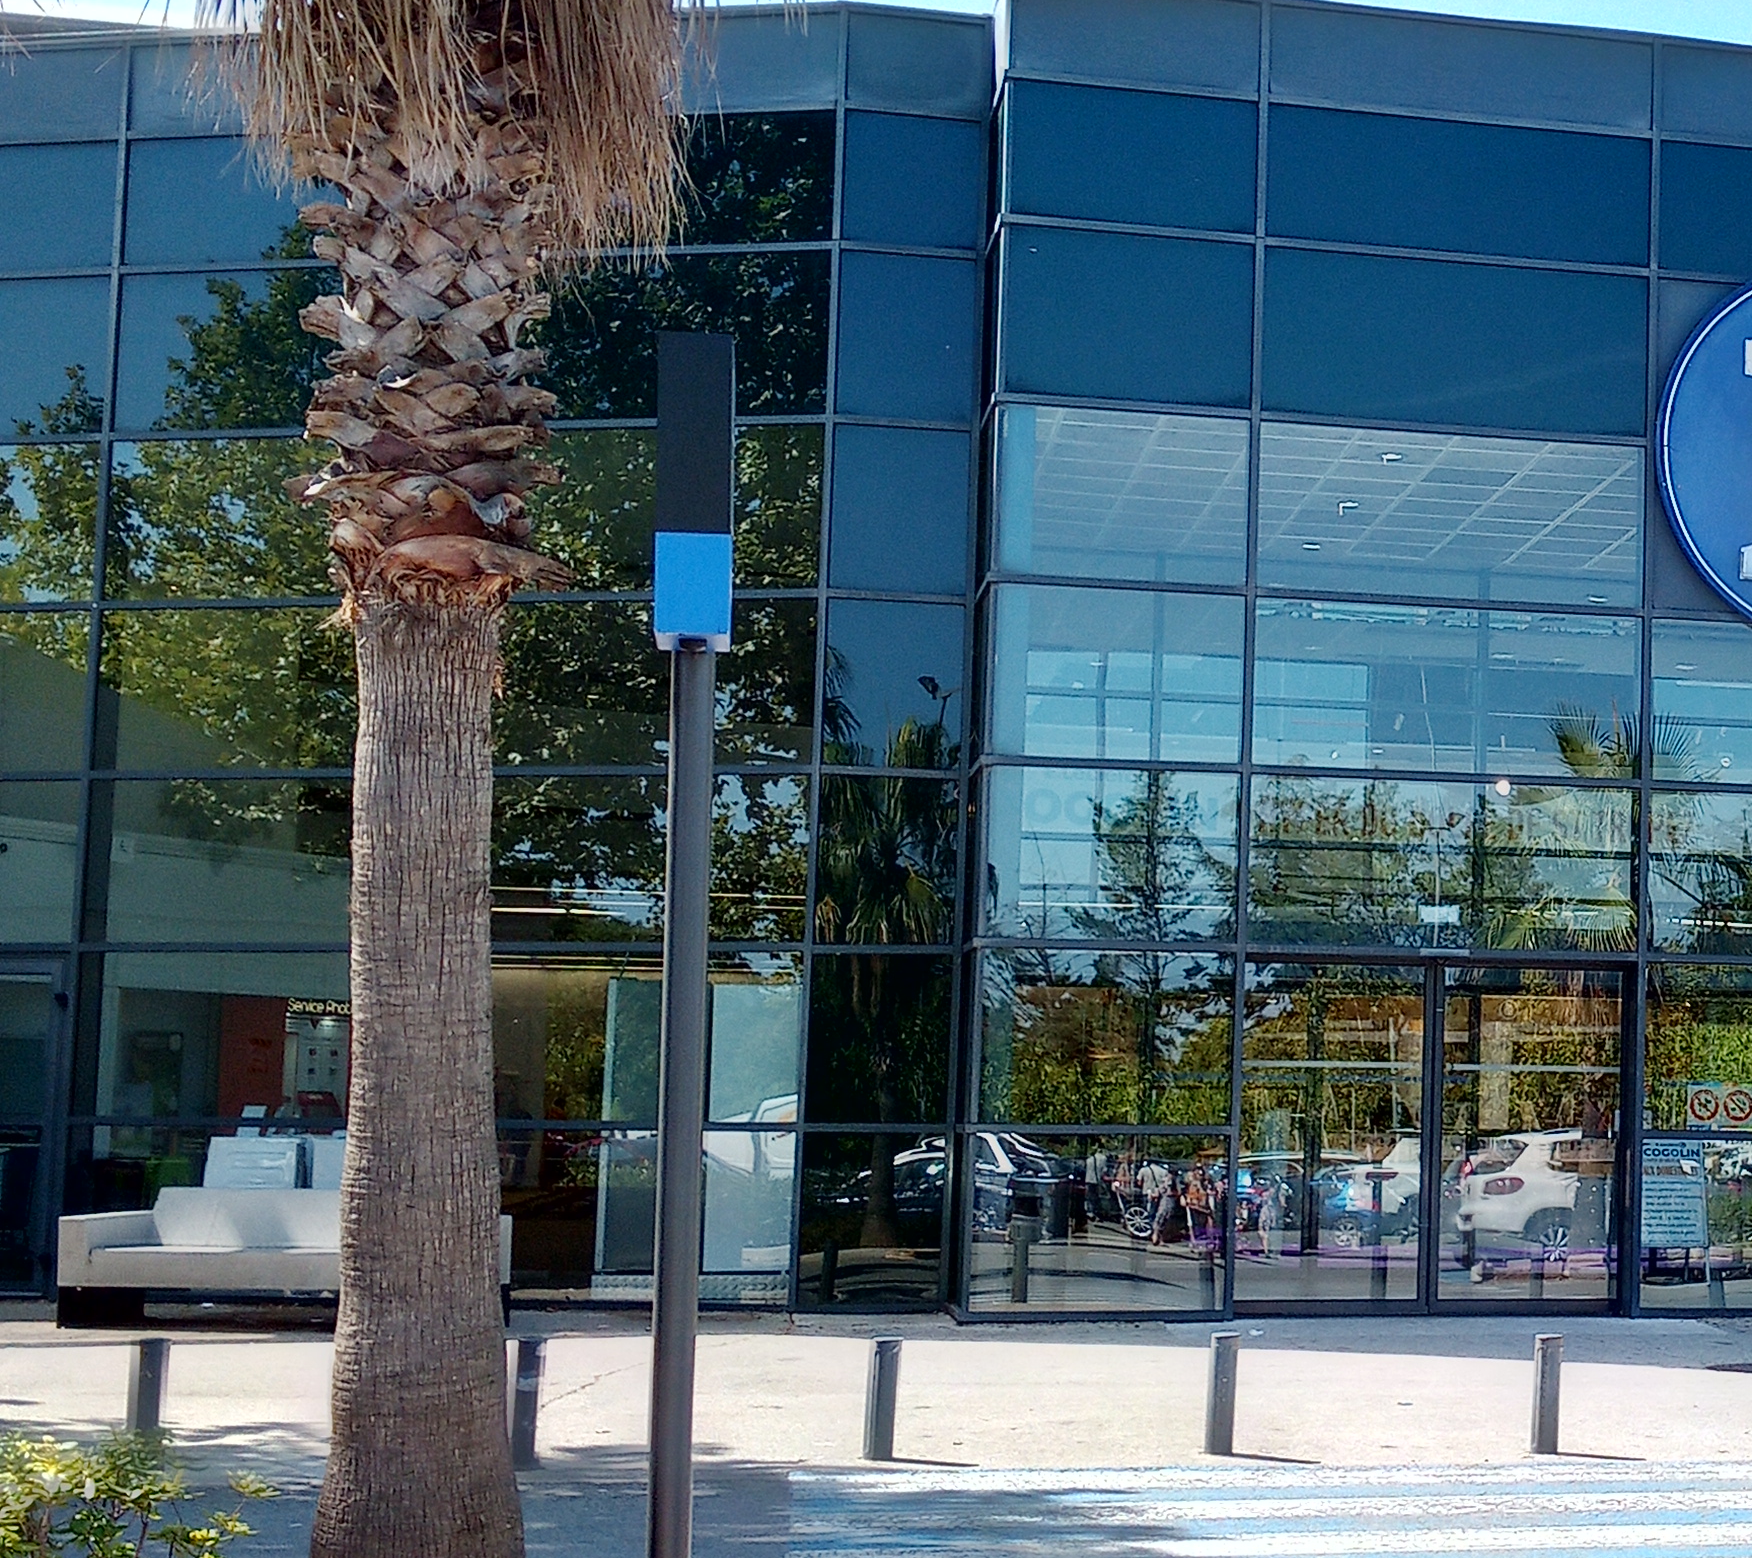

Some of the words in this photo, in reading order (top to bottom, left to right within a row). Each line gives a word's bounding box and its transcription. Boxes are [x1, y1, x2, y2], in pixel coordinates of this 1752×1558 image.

[287, 997, 325, 1014] Service
[325, 999, 351, 1015] Phot
[1643, 1147, 1701, 1158] COGOLIN
